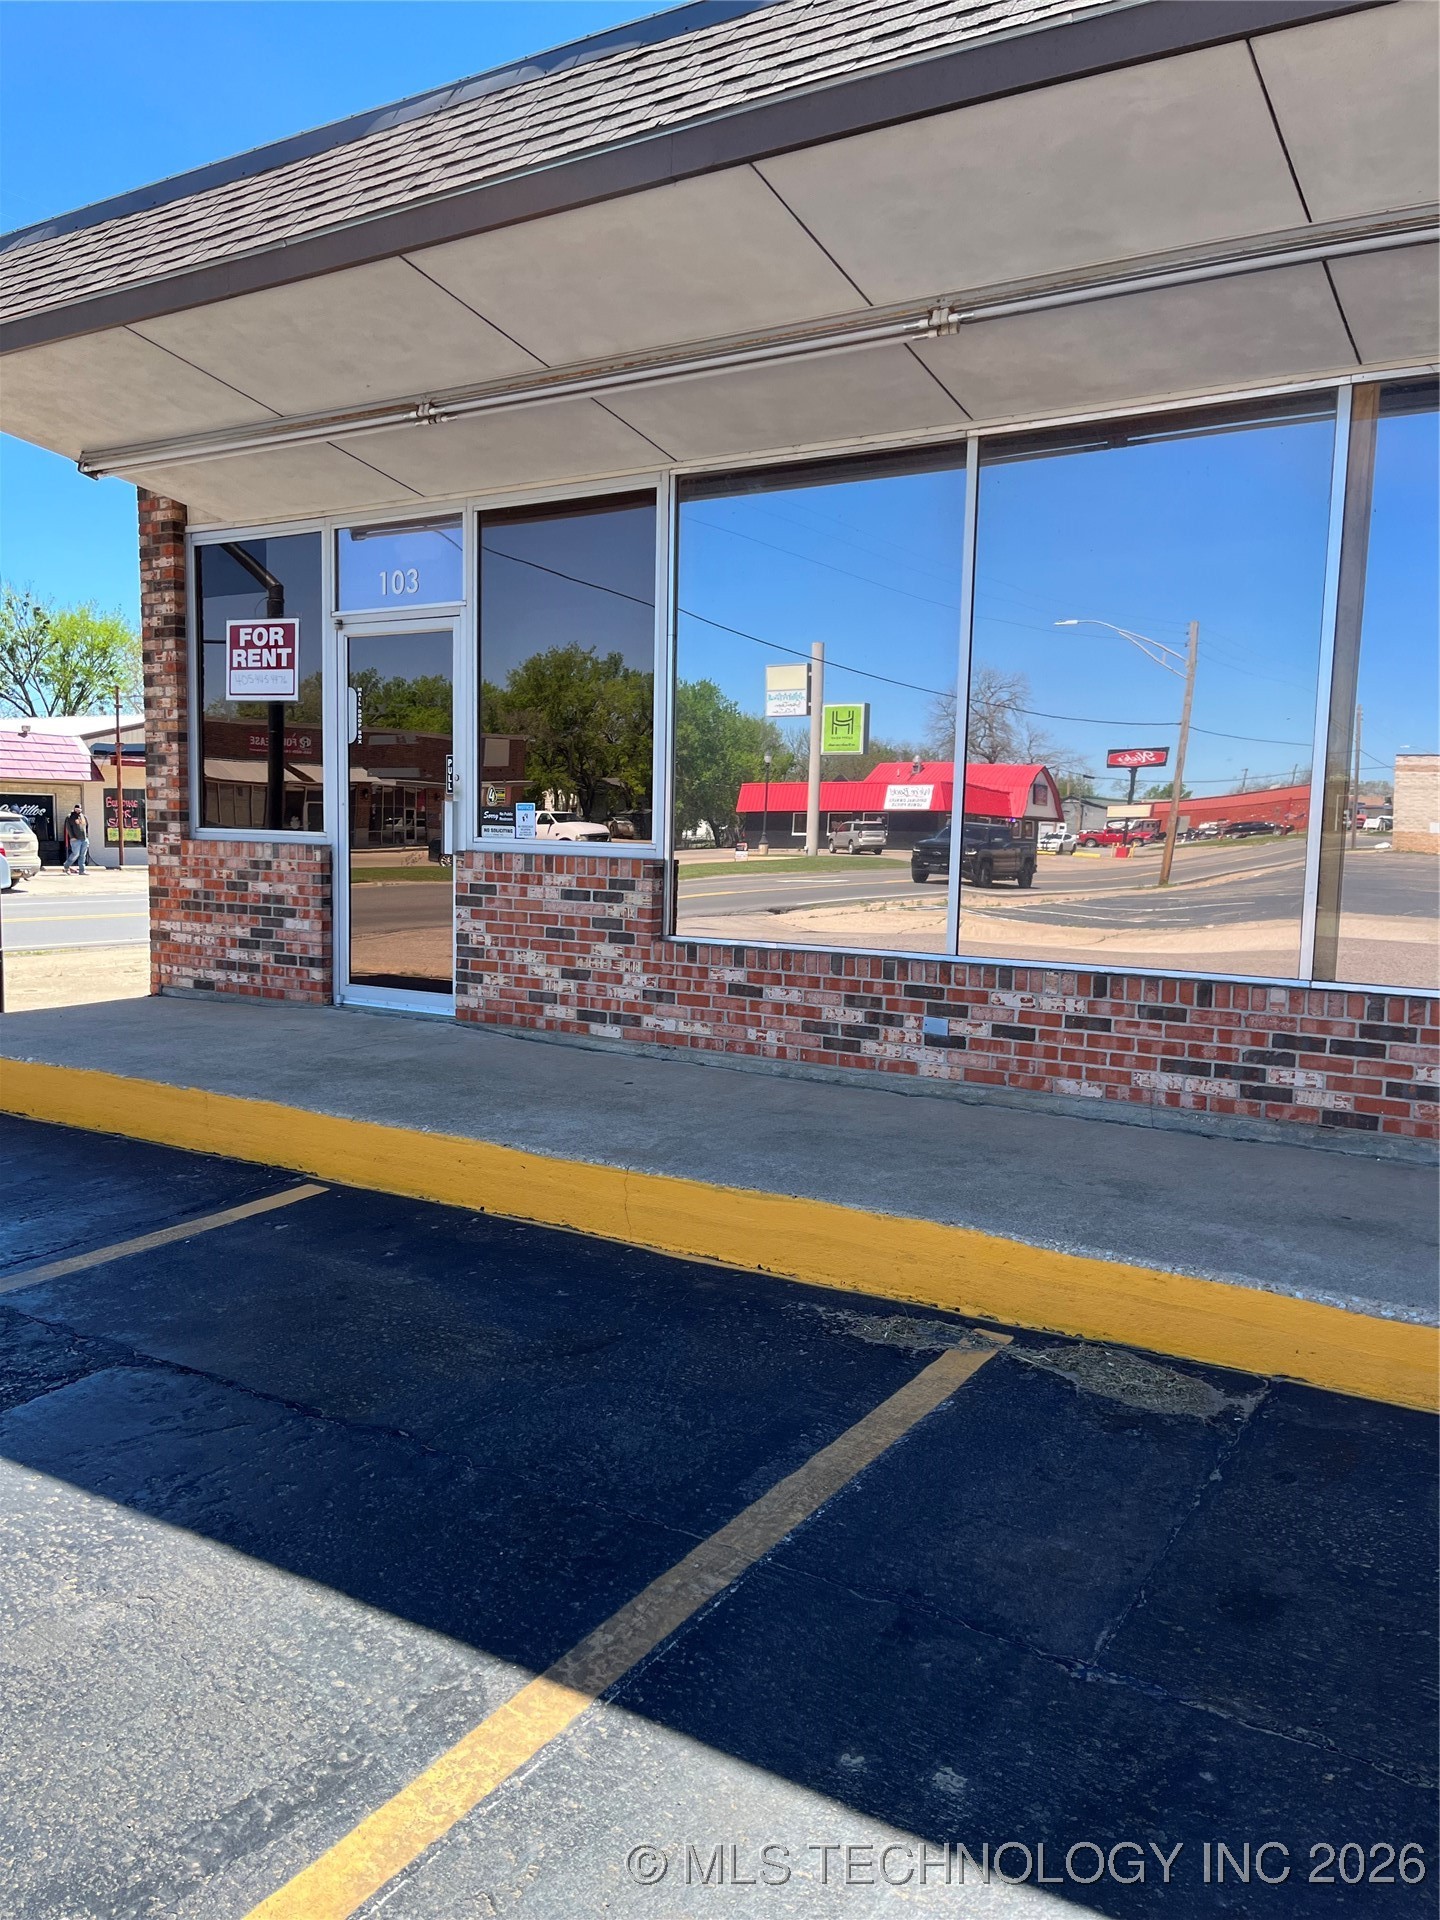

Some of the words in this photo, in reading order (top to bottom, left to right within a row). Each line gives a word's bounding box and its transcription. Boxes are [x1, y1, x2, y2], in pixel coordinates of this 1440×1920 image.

[379, 568, 420, 596] 103
[239, 627, 285, 647] FOR
[232, 648, 292, 668] RENT
[483, 810, 499, 820] Sorry
